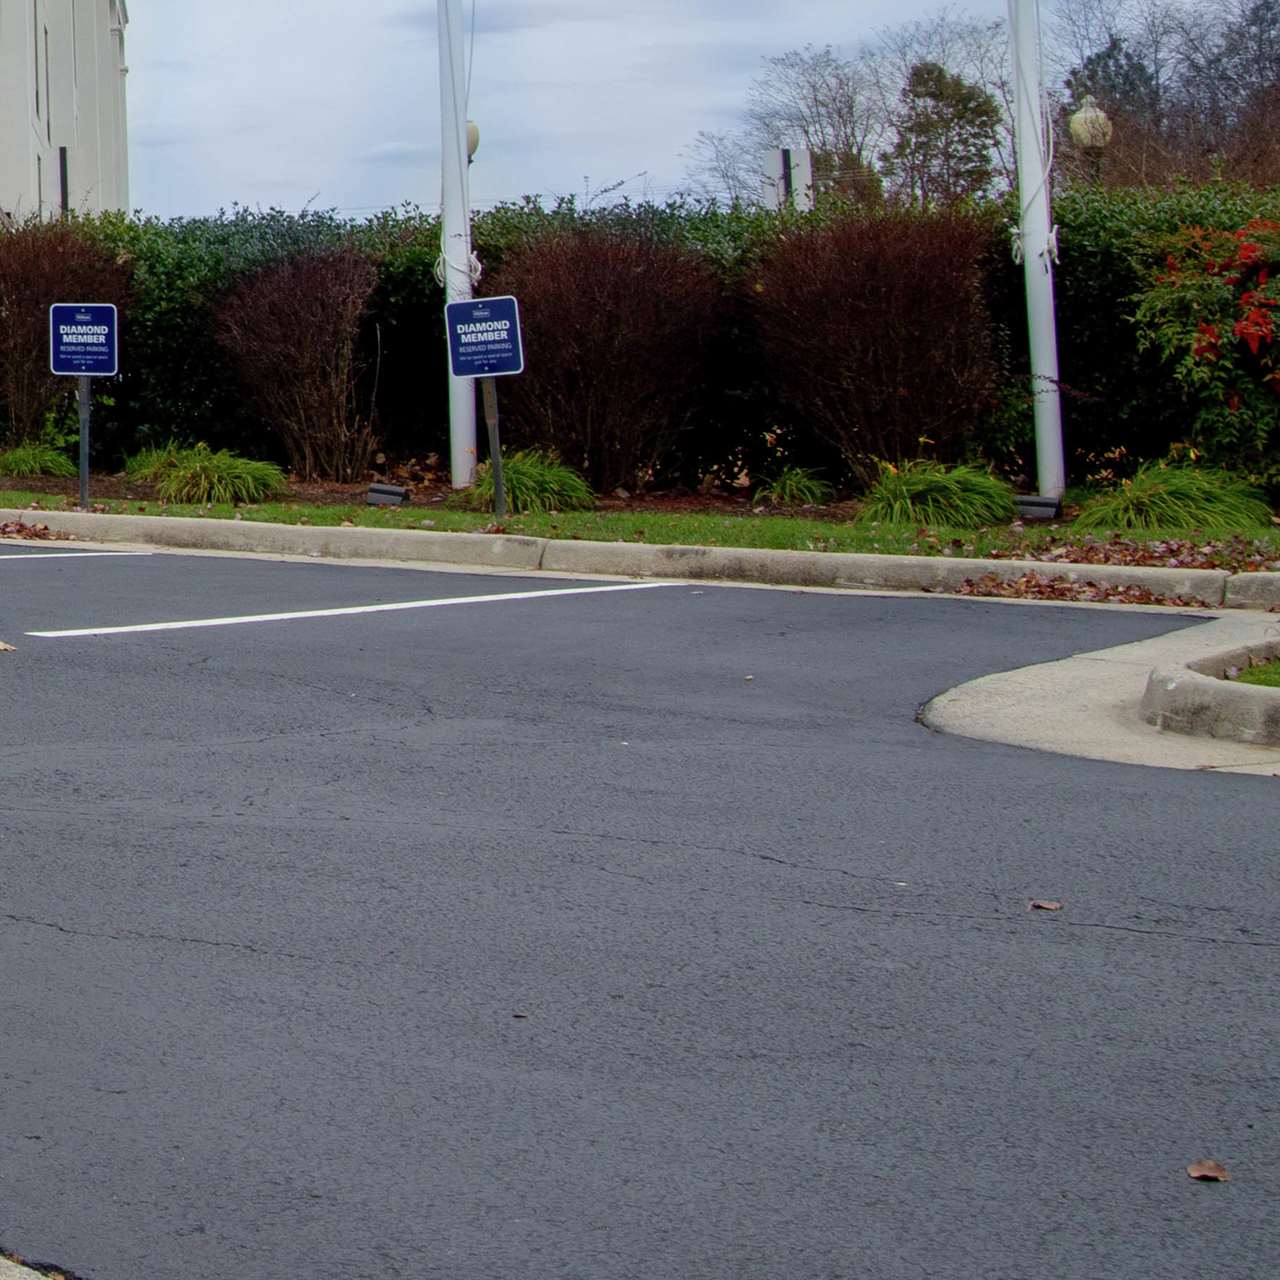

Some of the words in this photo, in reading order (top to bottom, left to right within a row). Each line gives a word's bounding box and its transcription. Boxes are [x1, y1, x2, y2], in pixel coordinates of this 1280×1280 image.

[59, 325, 109, 334] DIAMOND
[456, 320, 510, 334] DIAMOND
[62, 334, 106, 344] MEMBER
[461, 330, 508, 343] MEMBER
